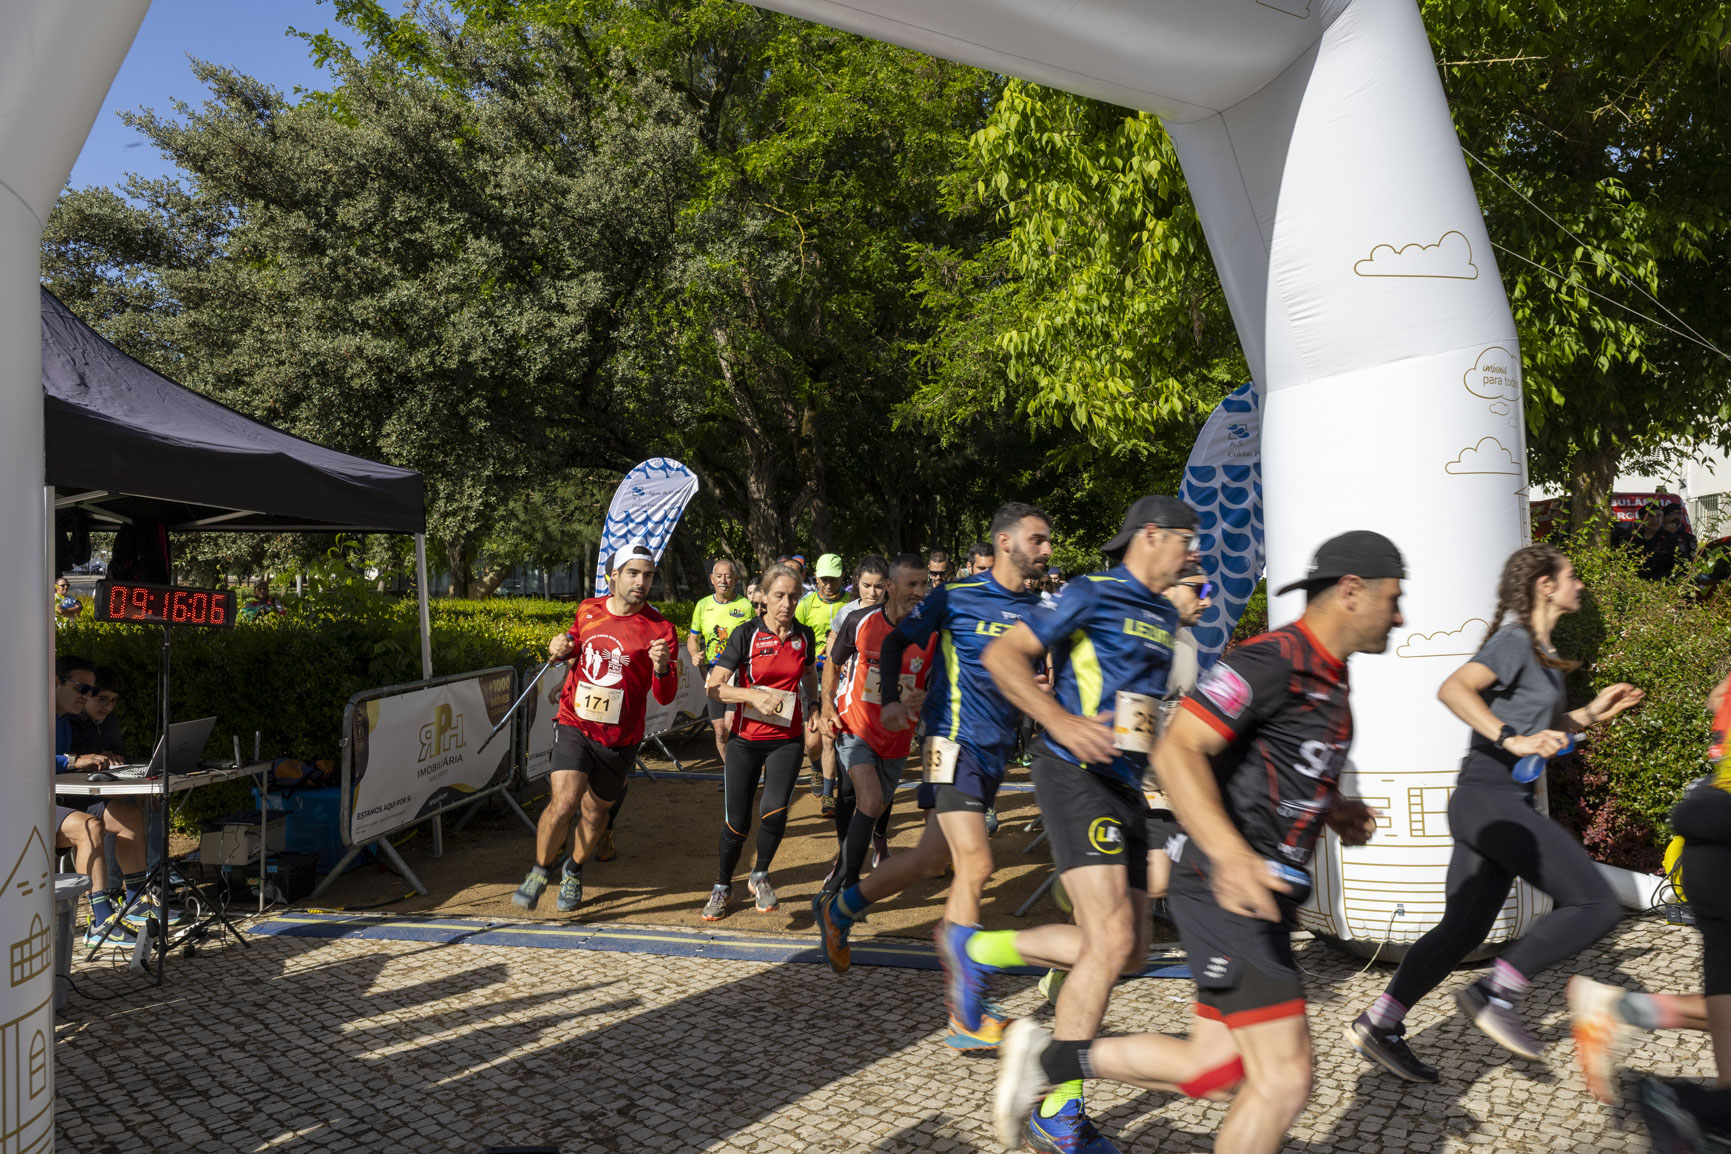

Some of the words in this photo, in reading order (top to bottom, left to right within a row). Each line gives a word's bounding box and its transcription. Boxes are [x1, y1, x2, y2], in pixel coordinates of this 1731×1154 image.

[1483, 376, 1503, 386] para
[109, 586, 226, 625] 09:16:06
[584, 694, 610, 712] 171
[417, 754, 463, 779] IMOBILIÁRIA
[357, 805, 383, 820] ESTAMOS
[383, 801, 396, 812] AQUI
[396, 797, 407, 807] POR
